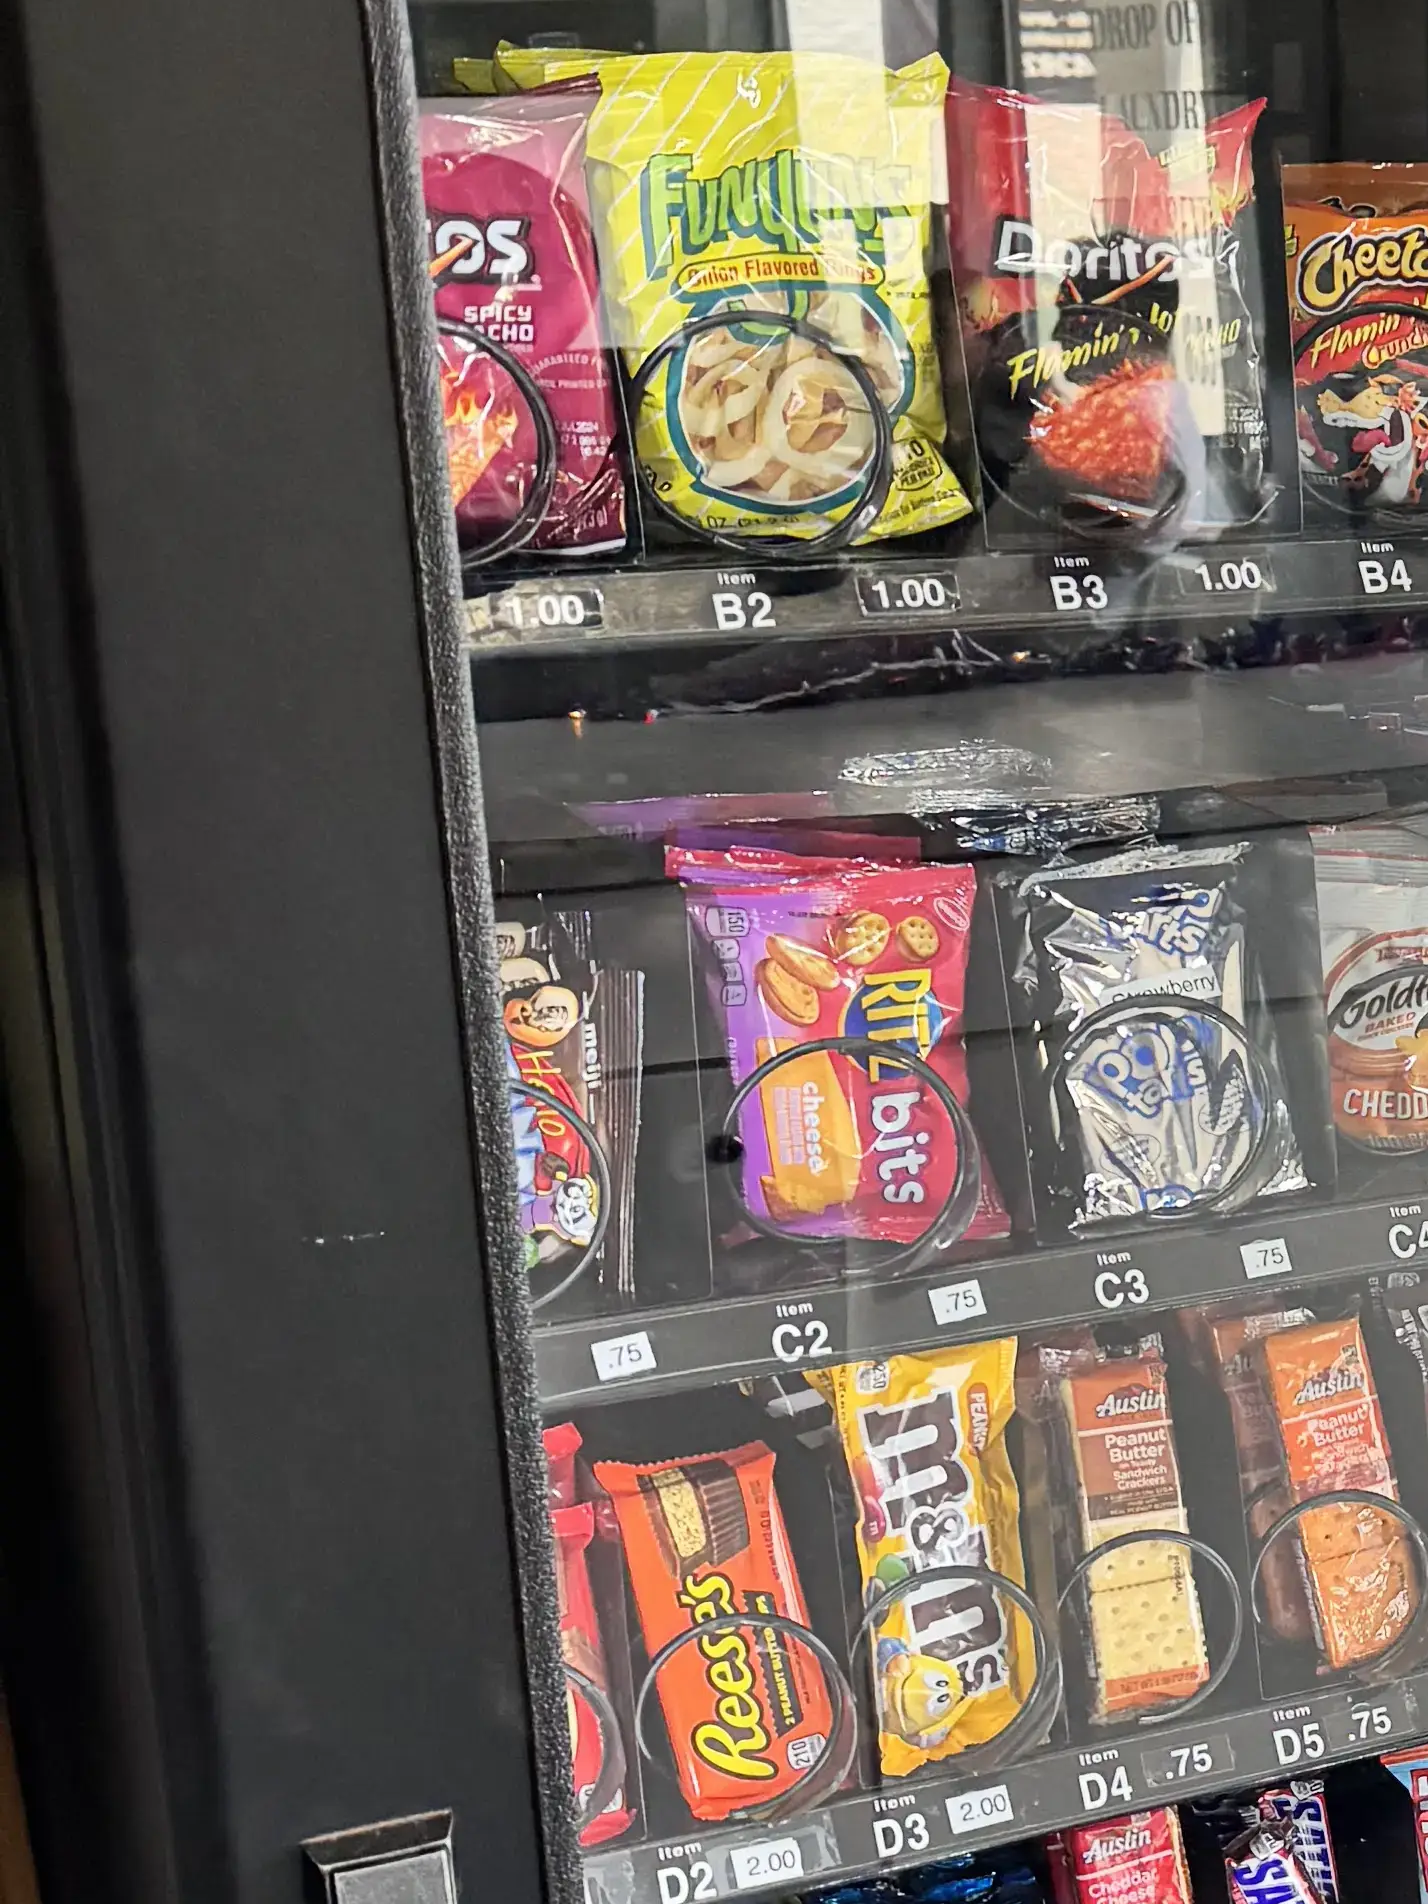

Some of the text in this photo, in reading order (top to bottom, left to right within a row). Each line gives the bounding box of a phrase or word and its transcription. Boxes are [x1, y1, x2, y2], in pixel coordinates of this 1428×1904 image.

[687, 255, 819, 290] Onion Flavored
[464, 305, 533, 324] SPICY
[1196, 560, 1262, 590] 1.00
[1358, 558, 1414, 594] B4
[870, 578, 947, 608] 1.00
[1050, 574, 1109, 611] B3
[504, 595, 585, 627] 1.00
[714, 592, 777, 631] B2
[801, 1081, 830, 1176] cheese
[870, 1091, 929, 1204] bits
[1256, 1246, 1285, 1268] .75
[946, 1289, 978, 1311] .75
[1094, 1268, 1150, 1309] C3
[607, 1344, 644, 1368] .75
[770, 1320, 832, 1361] C2
[1095, 1389, 1167, 1418] Austin
[1104, 1427, 1168, 1449] Peanut
[1109, 1443, 1166, 1464] Butter
[1113, 1463, 1168, 1481] Sandwich
[1117, 1476, 1166, 1491] Crackers
[680, 1573, 777, 1778] Reese's
[1347, 1708, 1392, 1743] .75
[1272, 1723, 1325, 1764] D5
[1163, 1743, 1213, 1780] .75
[1077, 1766, 1133, 1811] D4
[959, 1792, 1007, 1821] 2.00
[872, 1815, 931, 1857] D3
[1082, 1827, 1152, 1864] Austin
[746, 1850, 797, 1876] 2.00
[1088, 1867, 1158, 1899] Cheddar
